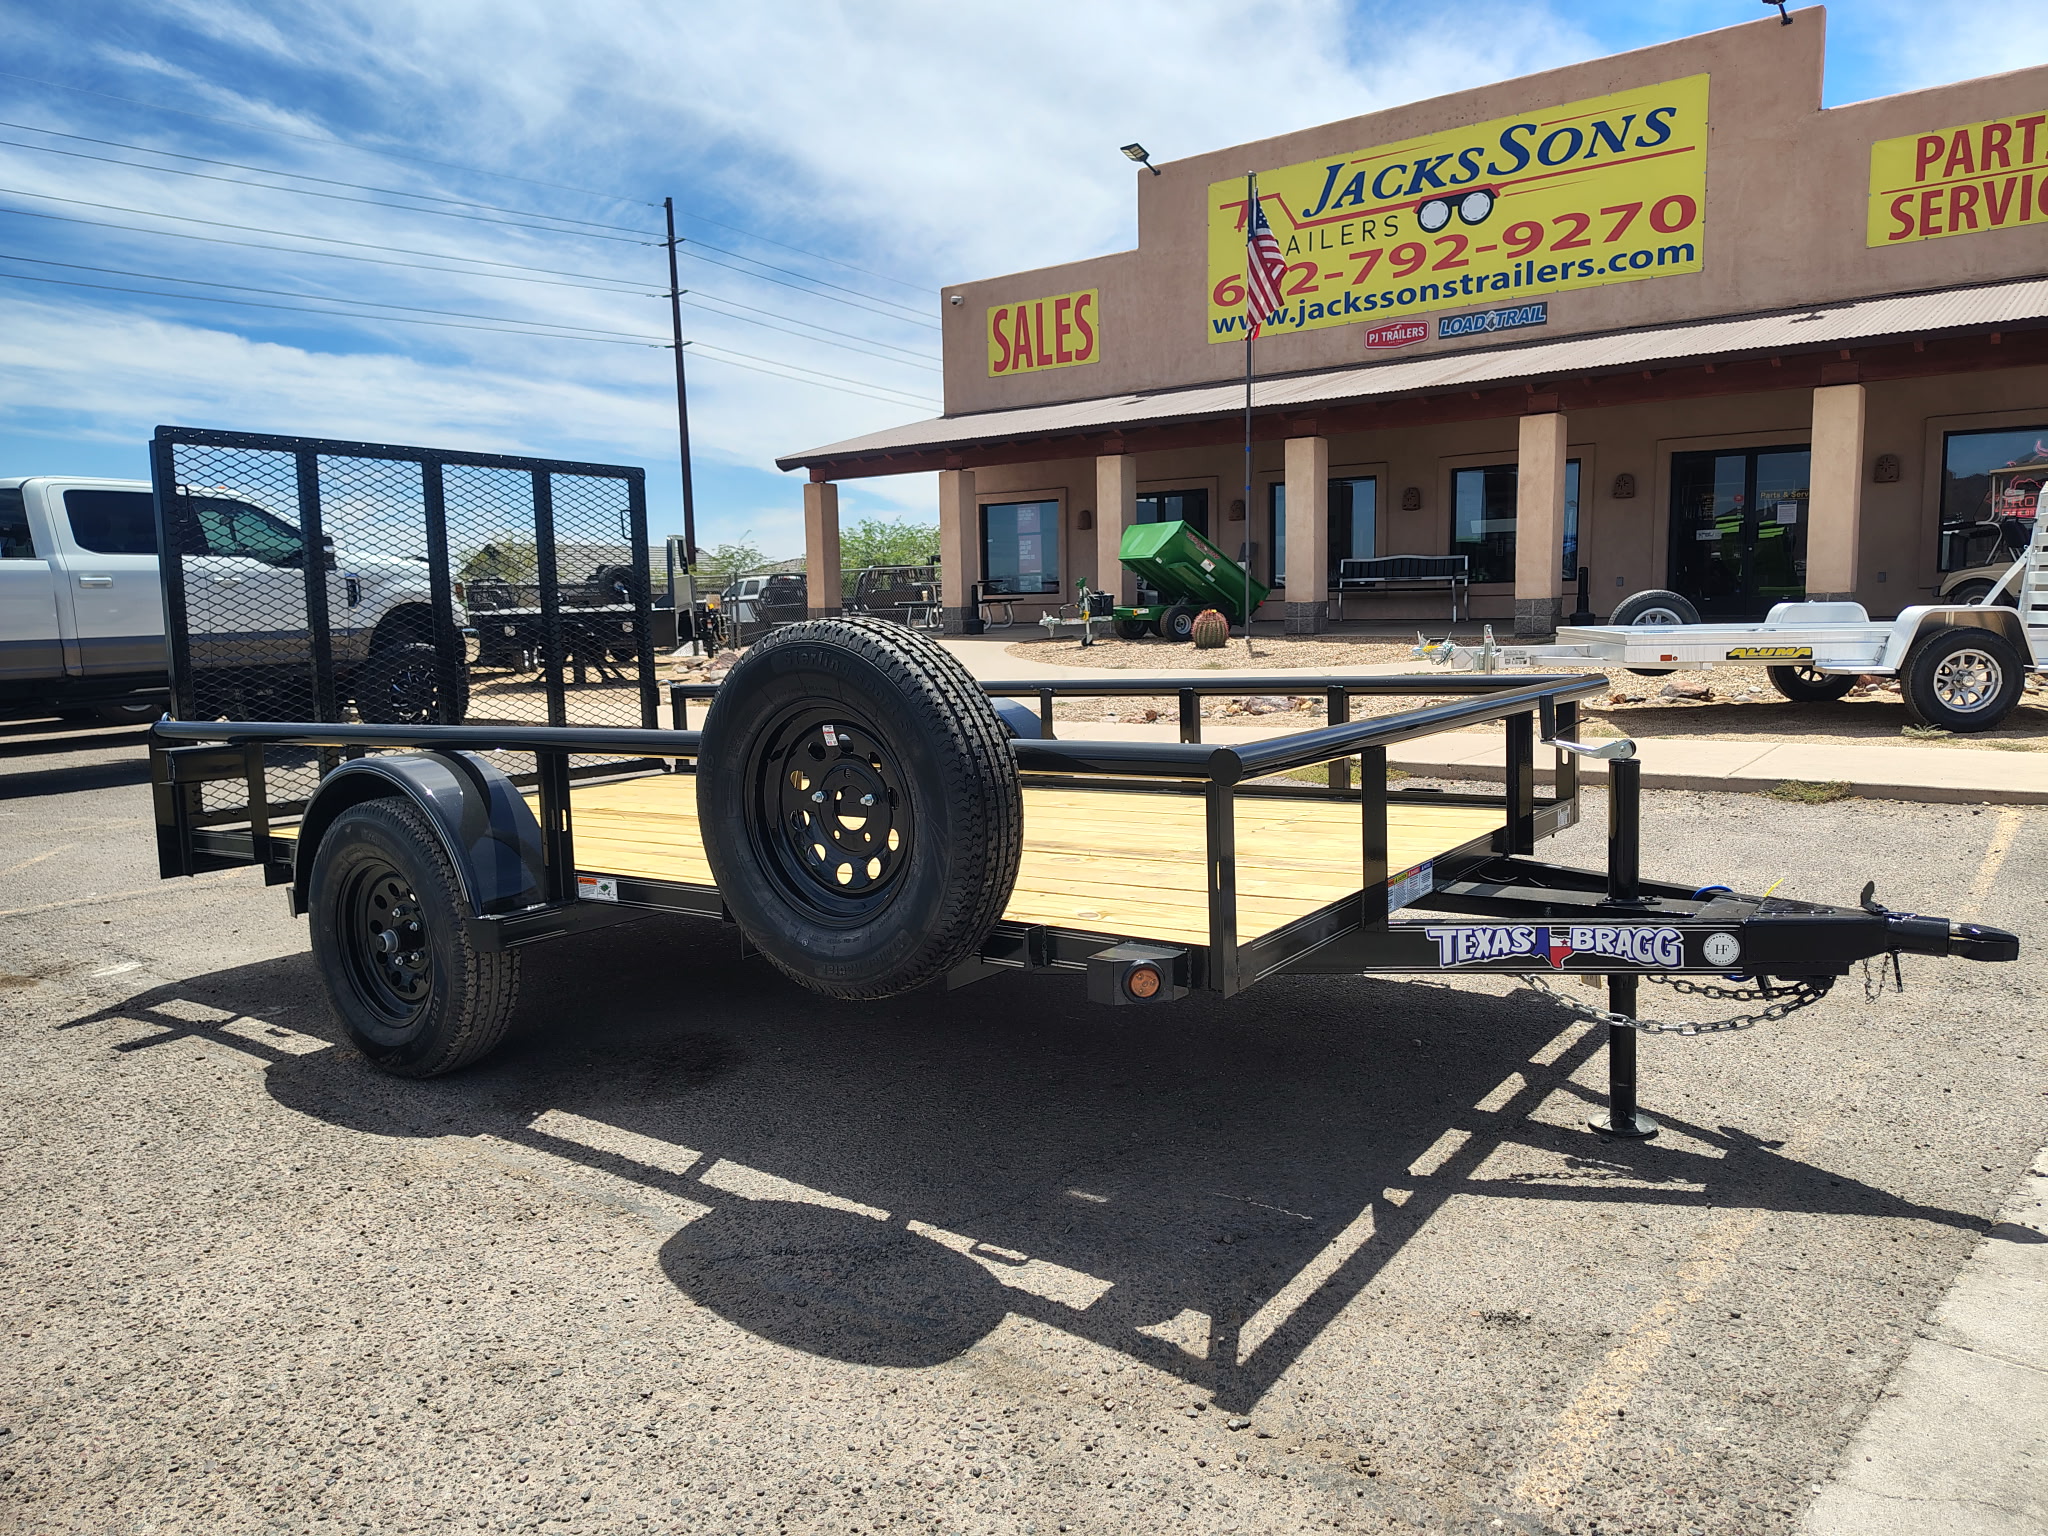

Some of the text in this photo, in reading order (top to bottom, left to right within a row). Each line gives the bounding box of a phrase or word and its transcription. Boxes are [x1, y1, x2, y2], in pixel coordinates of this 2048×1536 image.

[1915, 114, 2048, 183] PART
[1213, 194, 1698, 307] 62-792-9270
[1277, 214, 1399, 257] AILERS
[993, 294, 1094, 373] SALES
[1369, 326, 1425, 344] PJ TRAILERS
[1439, 305, 1547, 337] LOAD TRAIL
[1727, 647, 1812, 659] ALUMA
[1426, 926, 1684, 968] TEXAS BRAGG
[1715, 944, 1730, 954] HF
